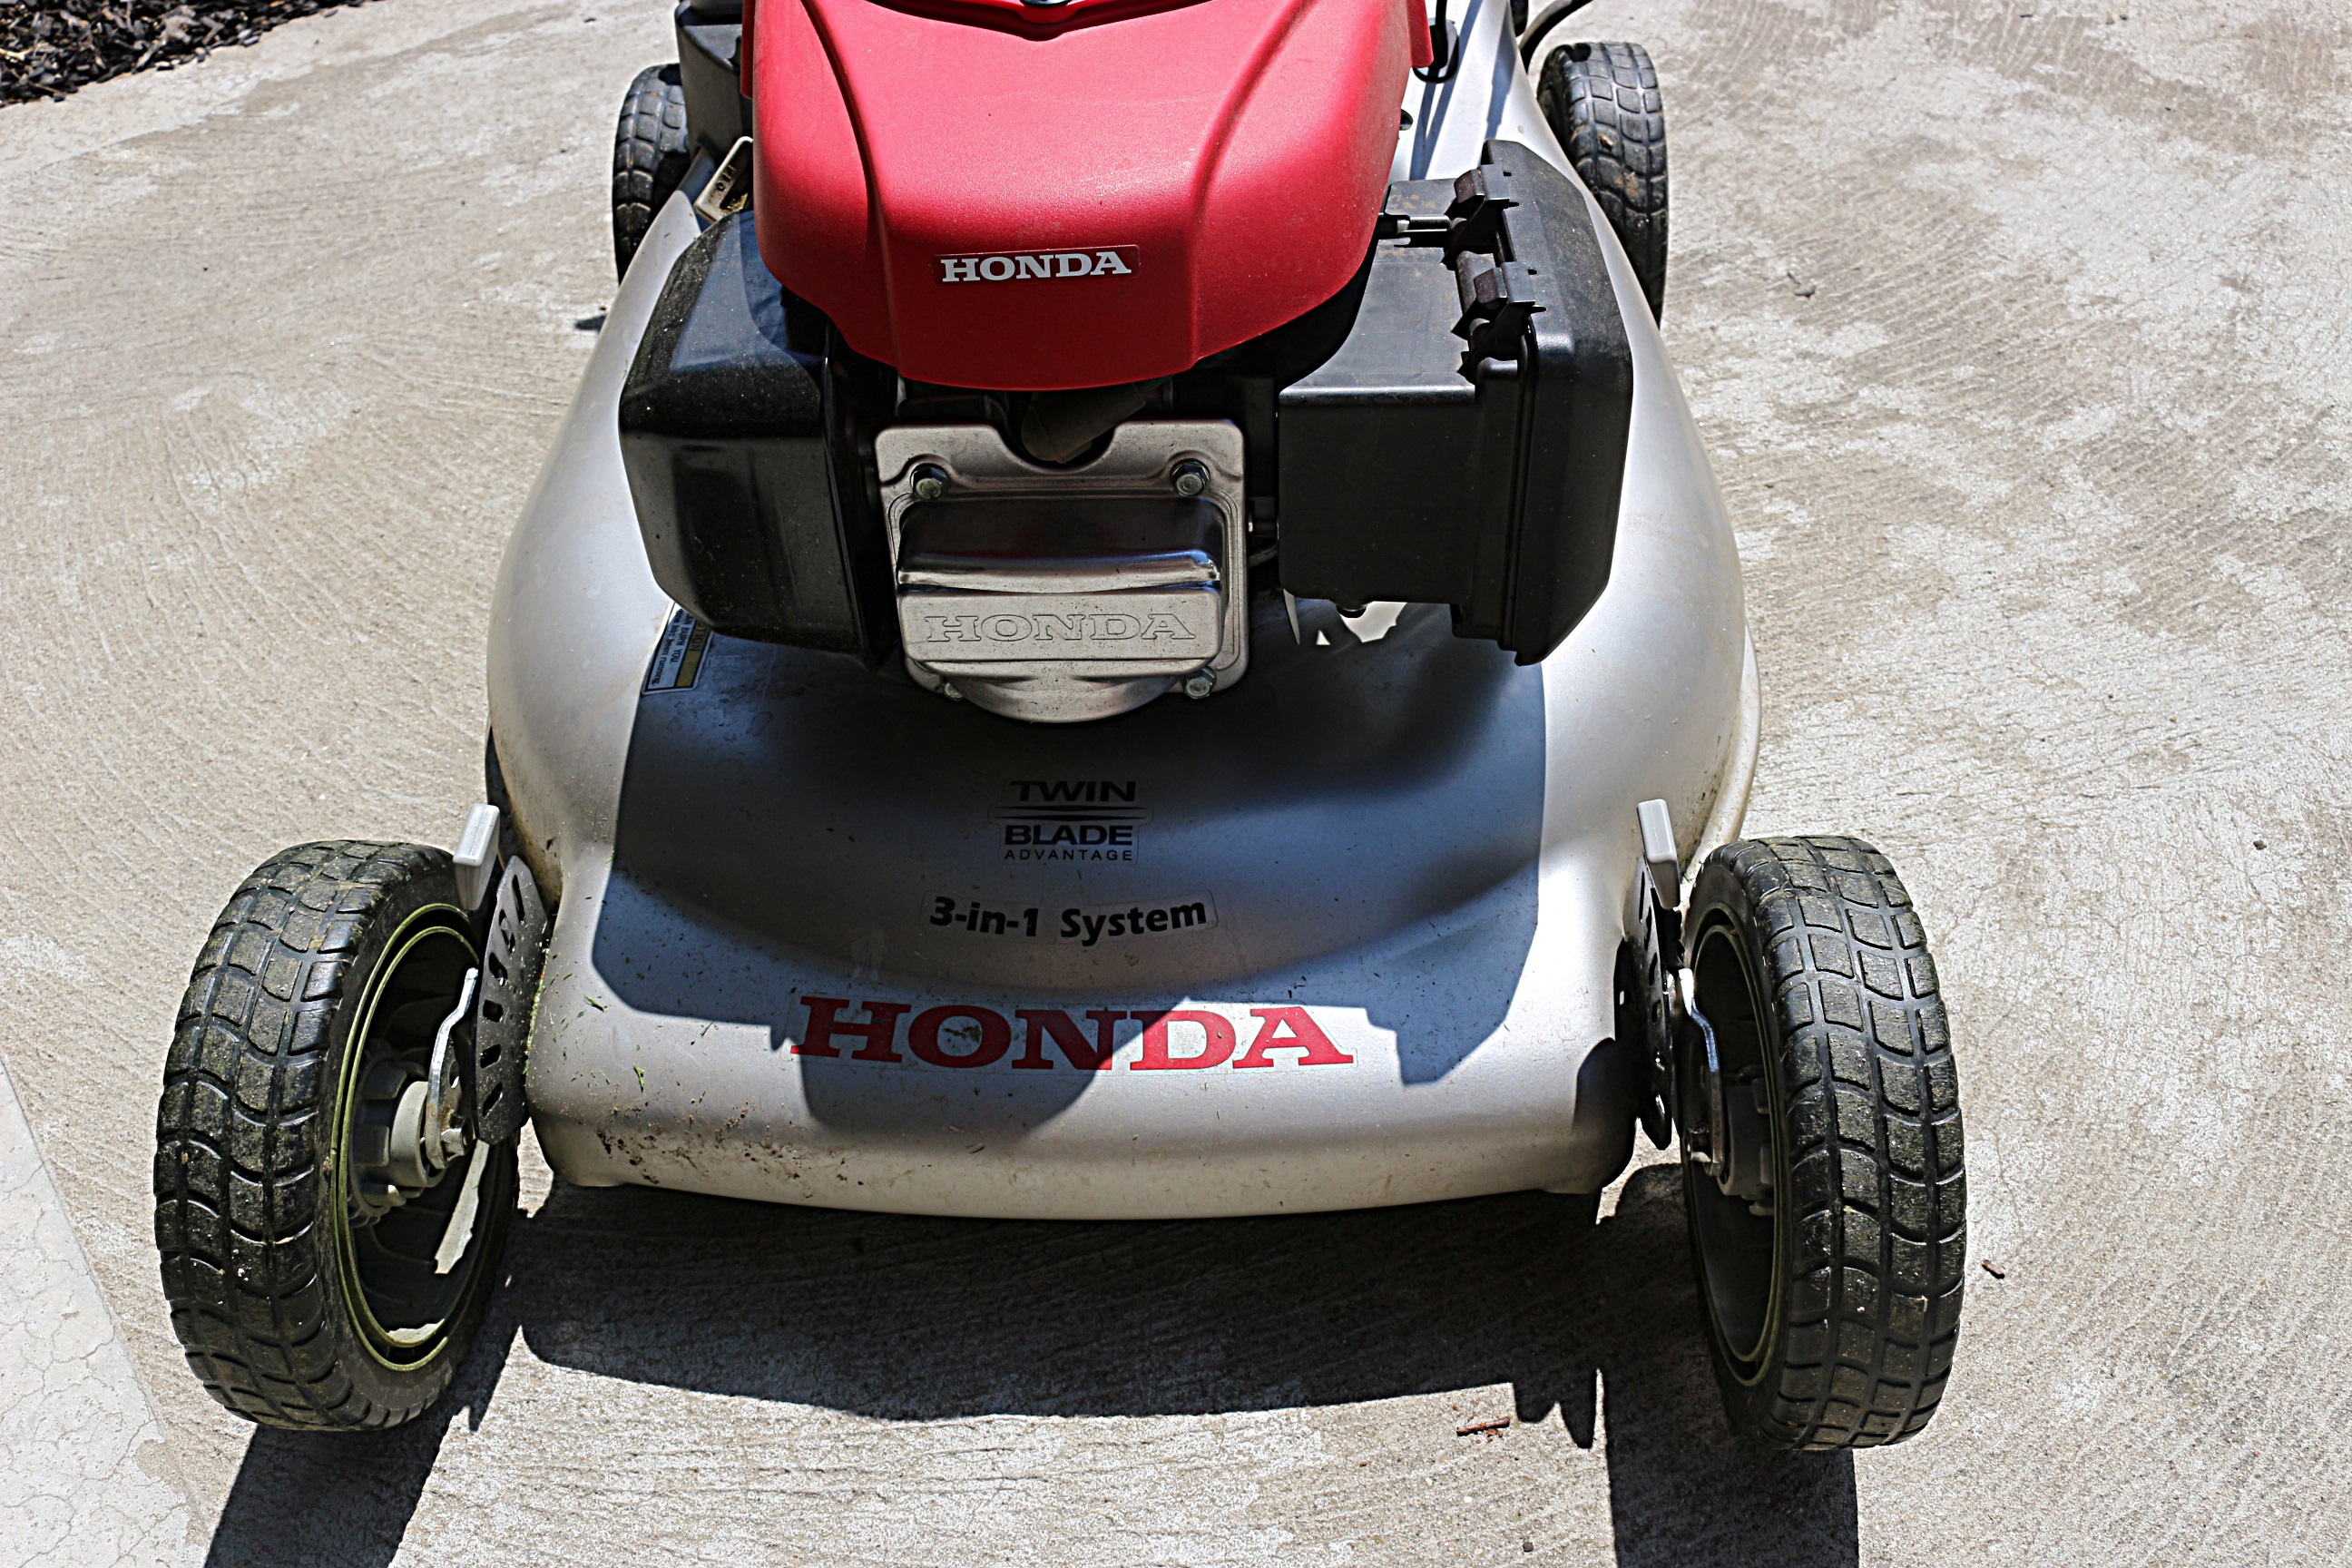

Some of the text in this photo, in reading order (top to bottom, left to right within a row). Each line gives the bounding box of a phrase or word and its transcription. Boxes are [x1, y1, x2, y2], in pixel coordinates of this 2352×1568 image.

[941, 251, 1132, 282] HONDA
[669, 625, 680, 637] has
[676, 627, 690, 646] BURN
[924, 613, 1196, 642] HONDA
[662, 639, 673, 656] been
[670, 648, 682, 663] YOU.
[652, 657, 667, 686] running.
[1010, 780, 1136, 802] TWIN
[1004, 825, 1133, 846] BLADE
[1004, 849, 1132, 861] ADVANTAGE
[929, 896, 1207, 946] 3-in-1 System
[790, 995, 1355, 1071] HONDA
